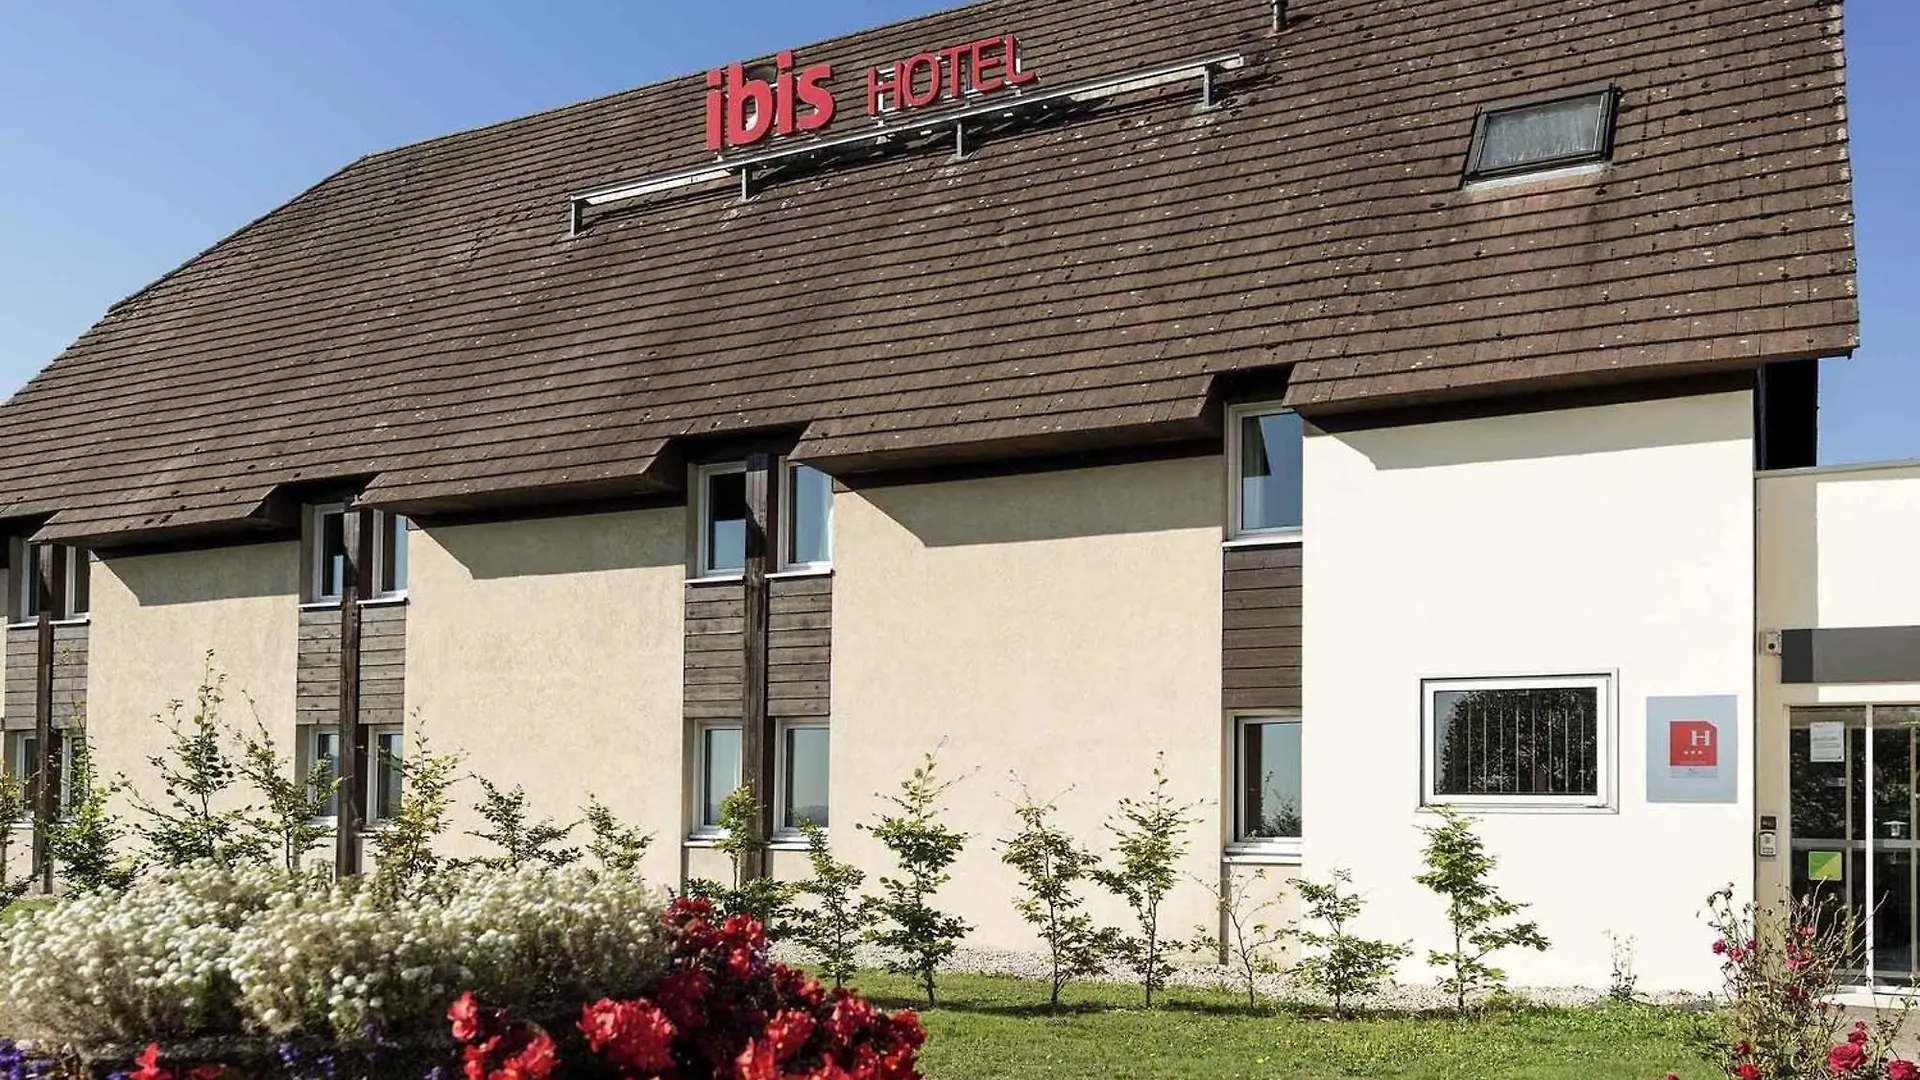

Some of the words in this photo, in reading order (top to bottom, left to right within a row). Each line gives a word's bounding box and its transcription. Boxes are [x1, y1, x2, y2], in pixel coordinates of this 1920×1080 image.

[706, 50, 836, 151] ibis
[867, 34, 1035, 117] HOTEL
[1691, 730, 1710, 746] H
